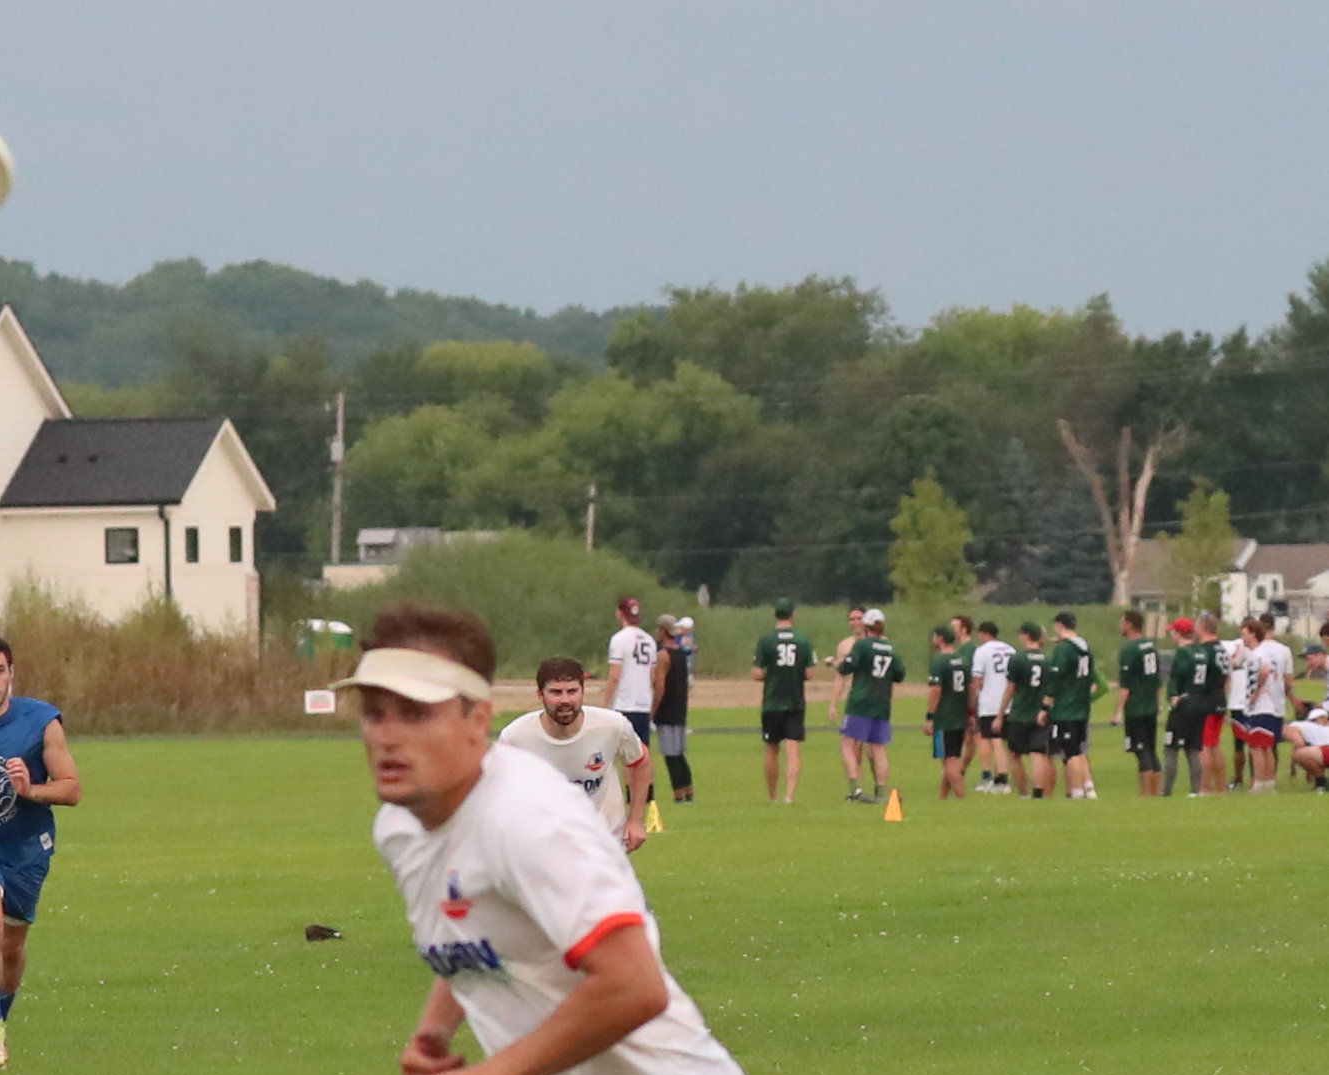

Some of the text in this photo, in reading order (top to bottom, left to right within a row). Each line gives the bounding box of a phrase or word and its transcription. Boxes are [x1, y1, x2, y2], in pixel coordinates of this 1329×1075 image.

[632, 642, 651, 665] 45
[776, 643, 797, 667] 36
[871, 654, 893, 678] 57
[1030, 664, 1042, 687] 2
